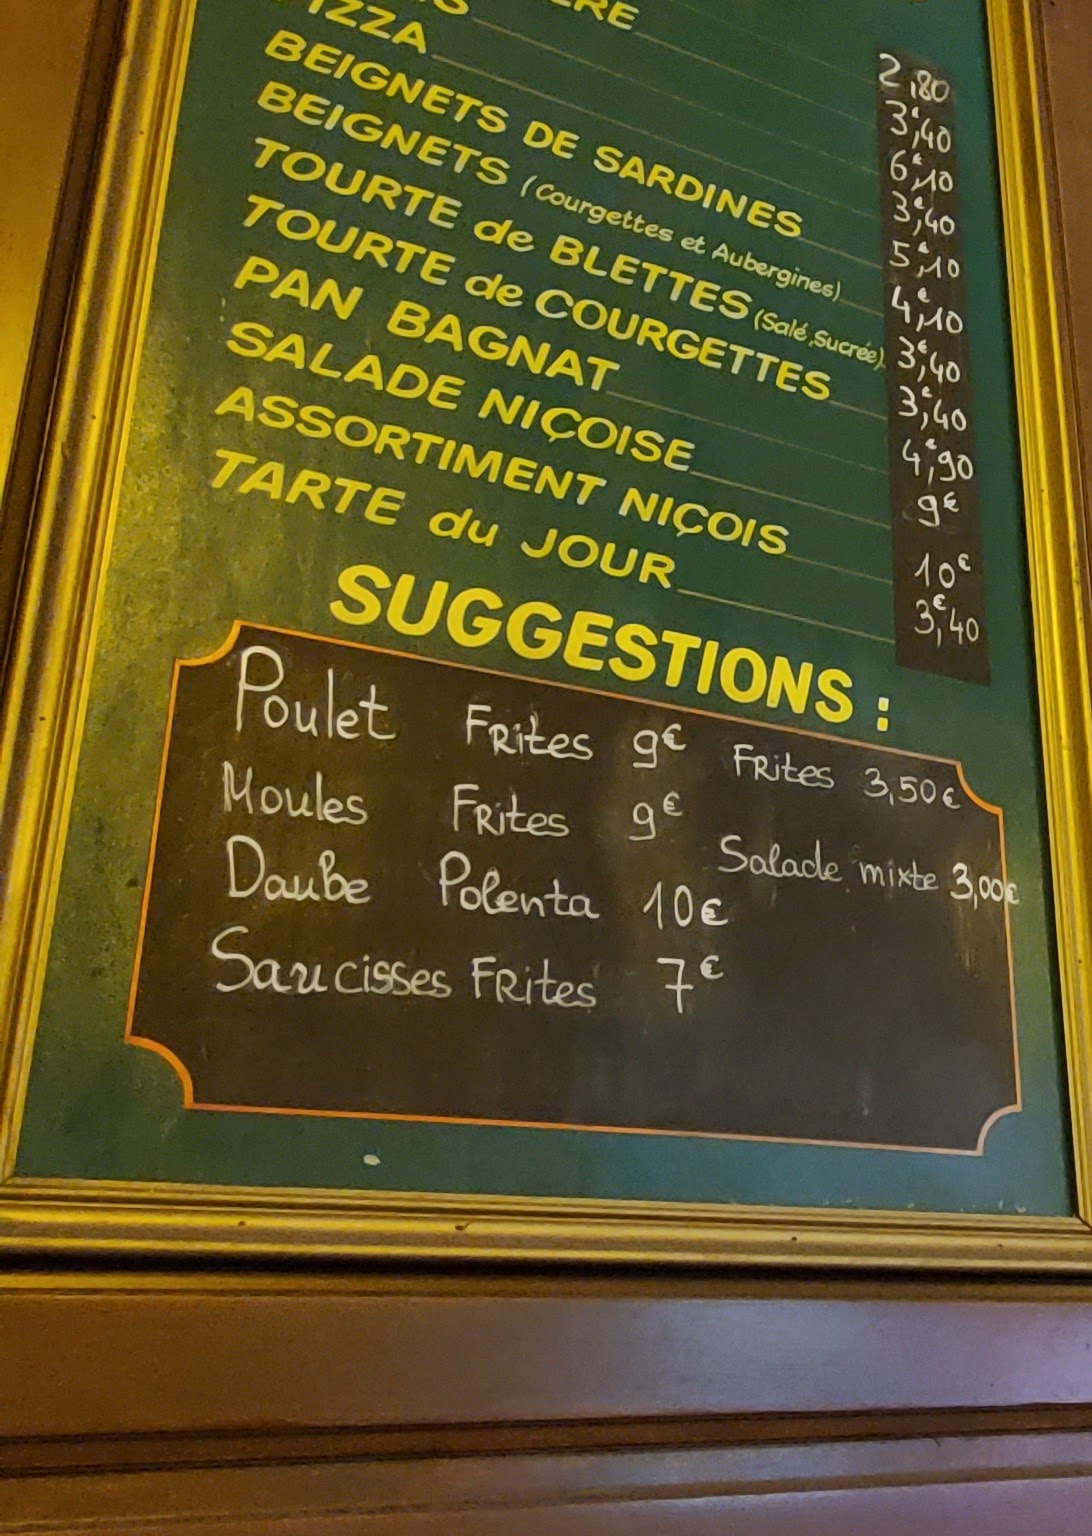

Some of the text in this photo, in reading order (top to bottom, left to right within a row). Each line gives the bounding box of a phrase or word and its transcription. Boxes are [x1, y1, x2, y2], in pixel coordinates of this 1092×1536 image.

[257, 80, 842, 302] BEIGNETS (Courgettes et Aubergines)
[265, 30, 803, 238] BEIGNETS DE SARDINES
[243, 195, 831, 401] TOURTE de COURGETTES
[255, 137, 463, 229] TOURTE
[474, 219, 535, 253] de
[550, 235, 753, 320] BLETTES
[226, 321, 696, 472] SALADE NIÇOISE
[234, 255, 621, 392] PAN BAGNAT
[211, 448, 676, 589] TARTE du JOUR
[214, 386, 789, 556] ASSORTIMENT NIÇOIS
[329, 563, 854, 724] SUGGESTIONS
[222, 760, 369, 825] Moules
[236, 645, 396, 741] Poulet
[863, 766, 961, 811] 3,50€
[225, 835, 729, 931] Daube Polenta 10€
[718, 834, 844, 883] Salade
[860, 860, 939, 893] mixte
[211, 925, 452, 999] Saucisses
[657, 954, 725, 1014] 7€
